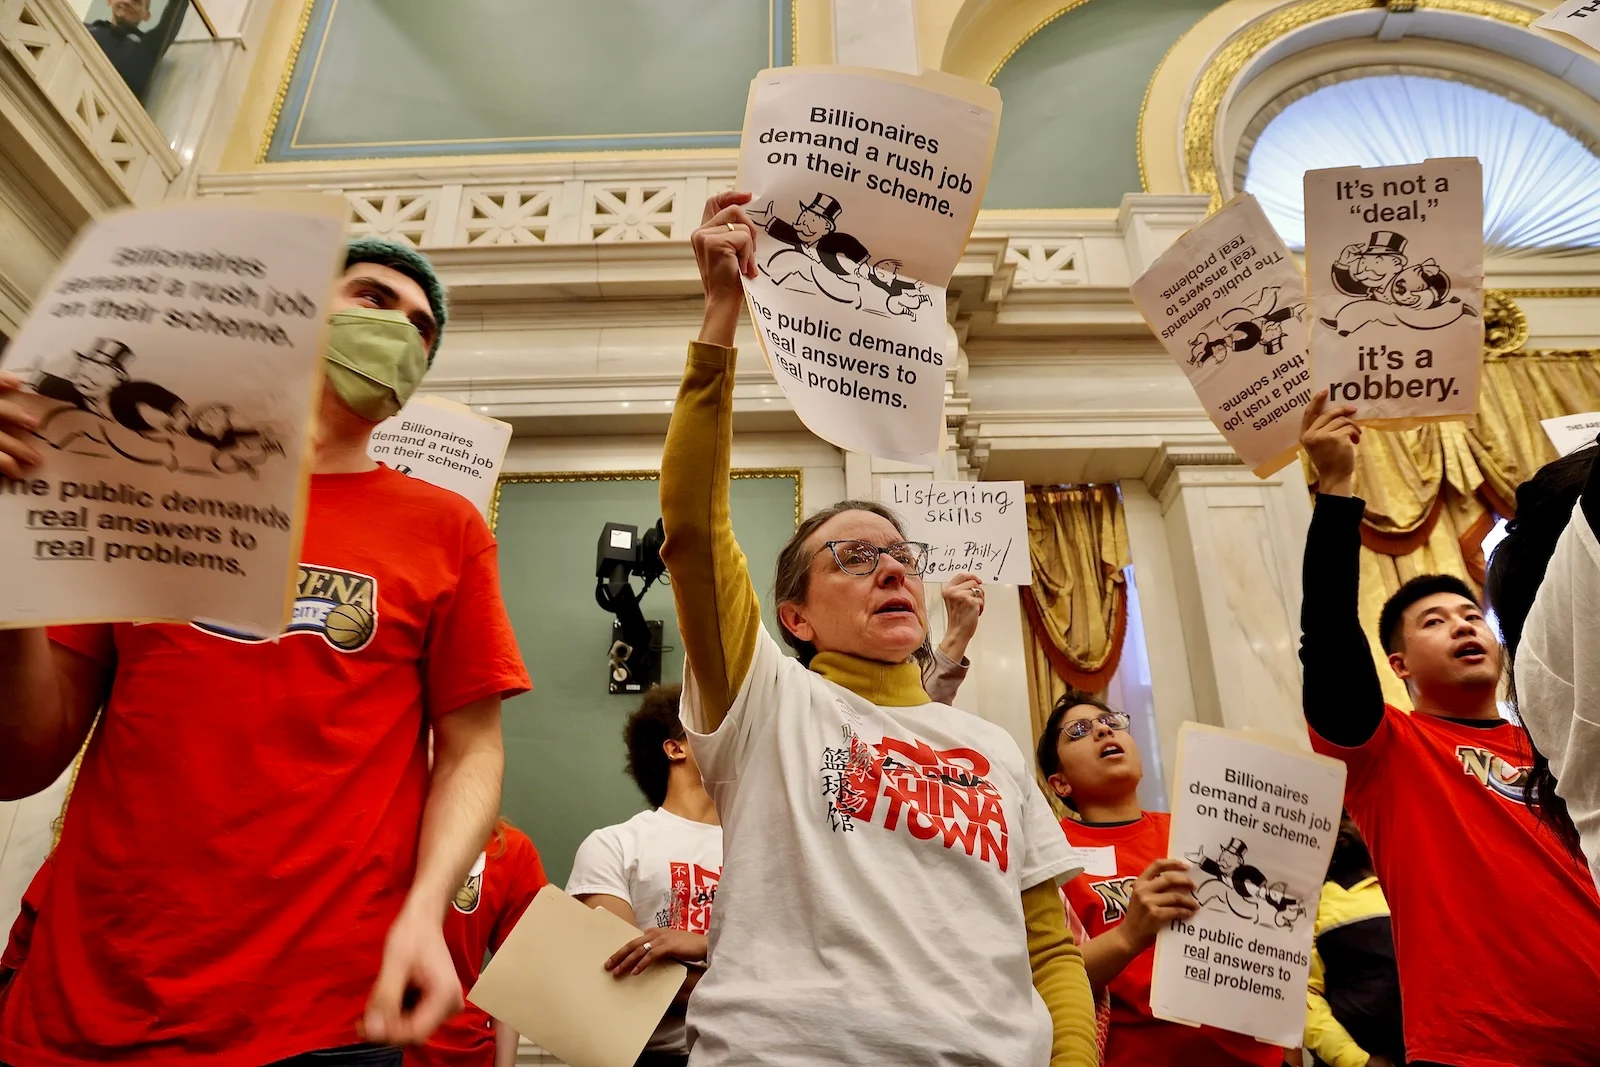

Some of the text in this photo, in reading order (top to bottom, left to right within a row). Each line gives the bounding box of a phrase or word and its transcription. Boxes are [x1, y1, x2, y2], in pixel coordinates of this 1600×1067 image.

[810, 107, 939, 154] Billionaires
[759, 128, 972, 195] demand a rush job
[767, 152, 954, 217] on their scheme.
[1336, 175, 1449, 201] It’s not a
[1160, 236, 1245, 300] real problems.
[1166, 246, 1257, 316] real answers to
[264, 284, 318, 321] job
[1161, 251, 1284, 339] The public demands
[748, 292, 943, 366] he public demands
[766, 327, 917, 385] real answers to
[1328, 345, 1459, 403] it’s a robbery.
[775, 352, 907, 409] real problems.
[1218, 354, 1304, 412] their scheme.
[1223, 369, 1310, 431] and a rush job
[1252, 388, 1312, 430] llionaires
[372, 431, 494, 469] demand a rush job
[401, 421, 474, 448] Billionaires
[373, 445, 482, 479] on their scheme.
[59, 479, 155, 509] public
[160, 490, 291, 532] demands
[893, 482, 1014, 514] Listening
[27, 507, 258, 551] real answers to
[944, 544, 956, 557] in
[34, 536, 247, 577] real problems.
[884, 768, 1009, 835] HINA
[1189, 781, 1332, 833] demand a rush job
[1225, 768, 1309, 805] Billionaires
[883, 786, 1009, 873] TOWN
[1196, 803, 1320, 850] on their scheme.
[1184, 944, 1291, 982] real answers to
[1198, 927, 1244, 949] public
[1247, 938, 1308, 967] demands
[1185, 964, 1285, 1001] real problems.
